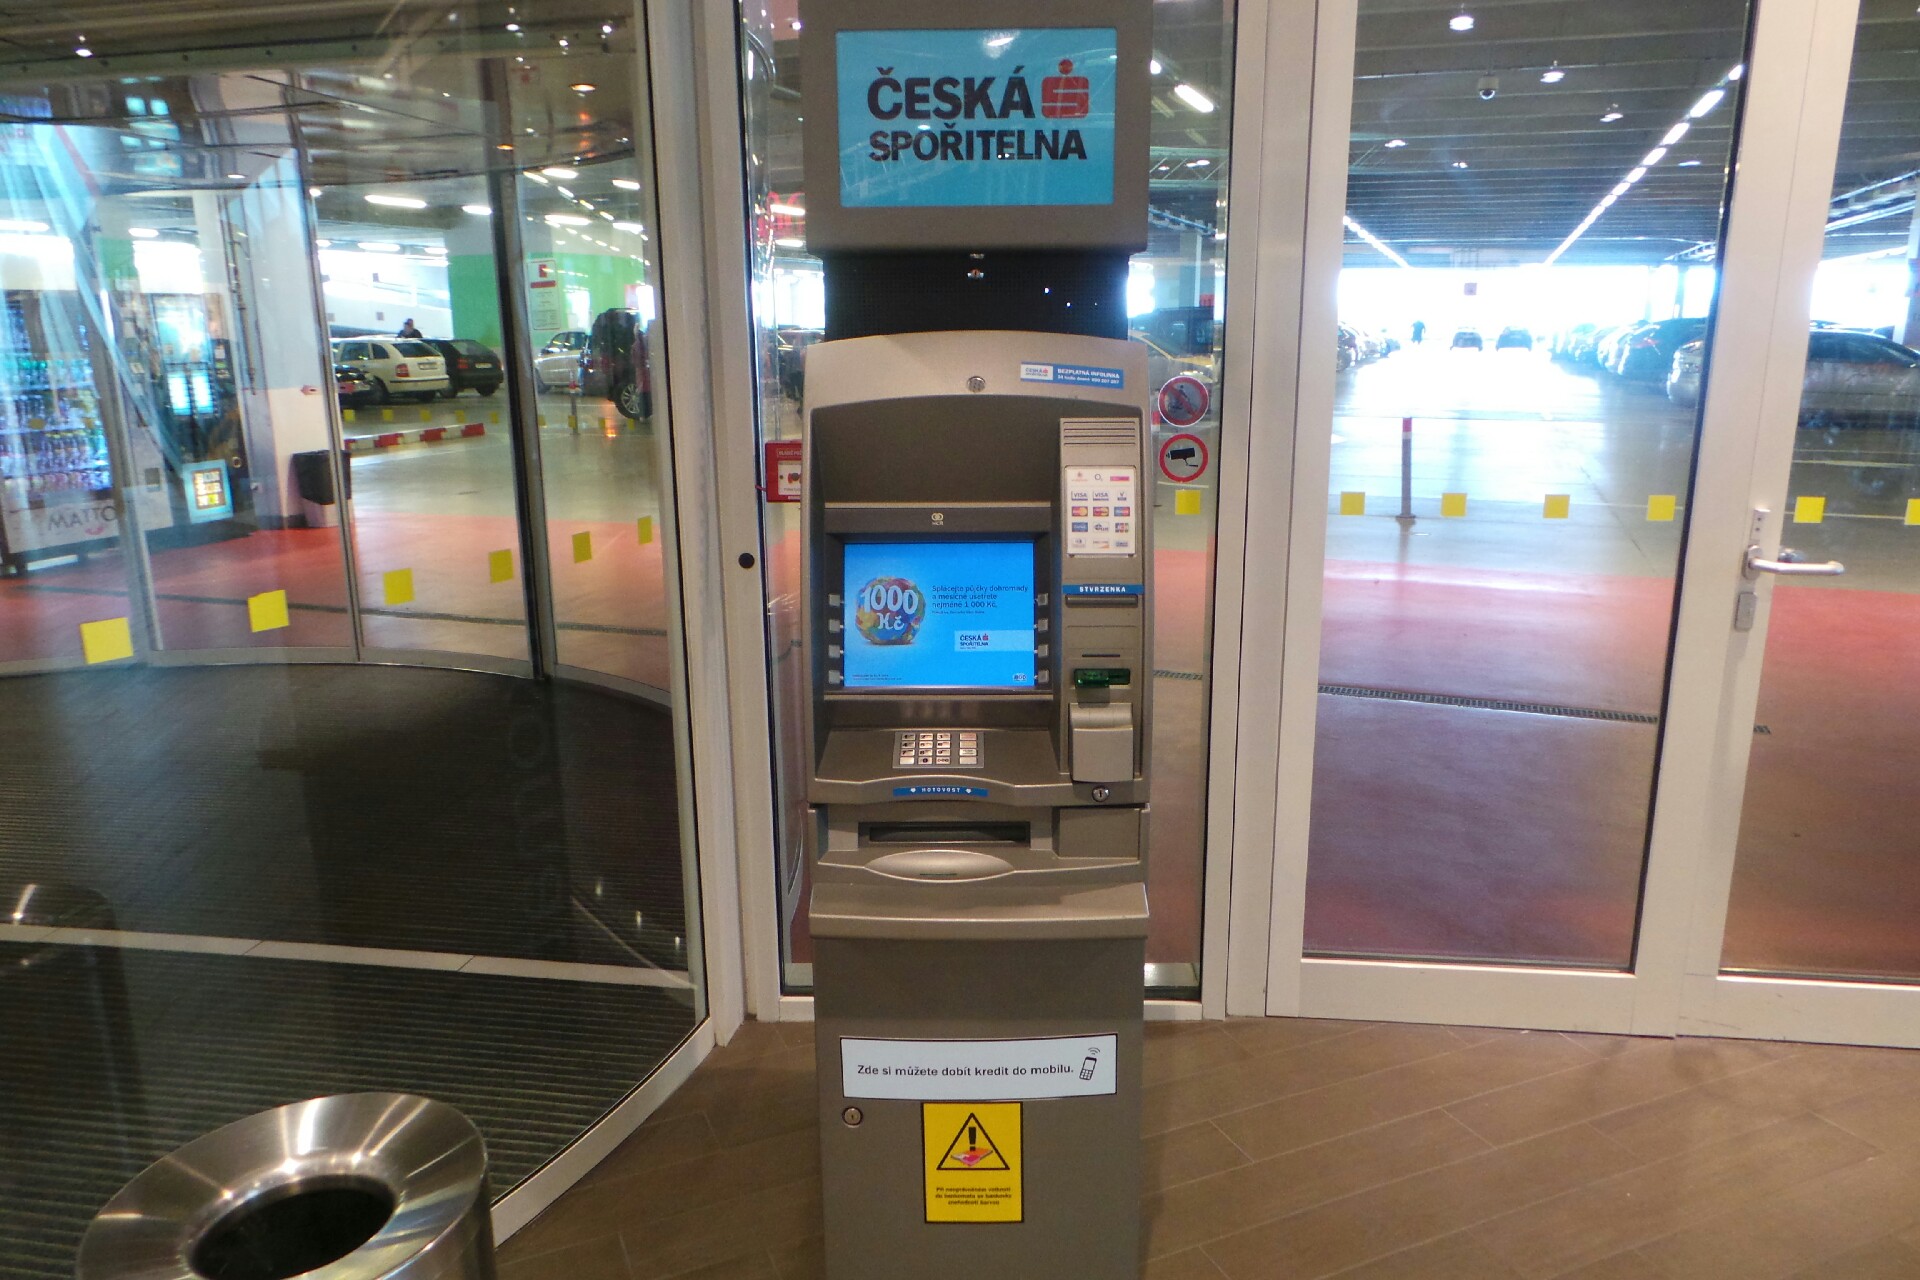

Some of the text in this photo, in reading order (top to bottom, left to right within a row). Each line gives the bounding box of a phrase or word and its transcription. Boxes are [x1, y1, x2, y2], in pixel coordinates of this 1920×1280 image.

[868, 66, 1035, 120] ČESKÁ
[868, 123, 1087, 161] SPOŘITELNA
[860, 584, 918, 614] 1000
[876, 616, 904, 630] Kč
[857, 1064, 1074, 1076] Zde si můžete dobít kredit do mobilu.
